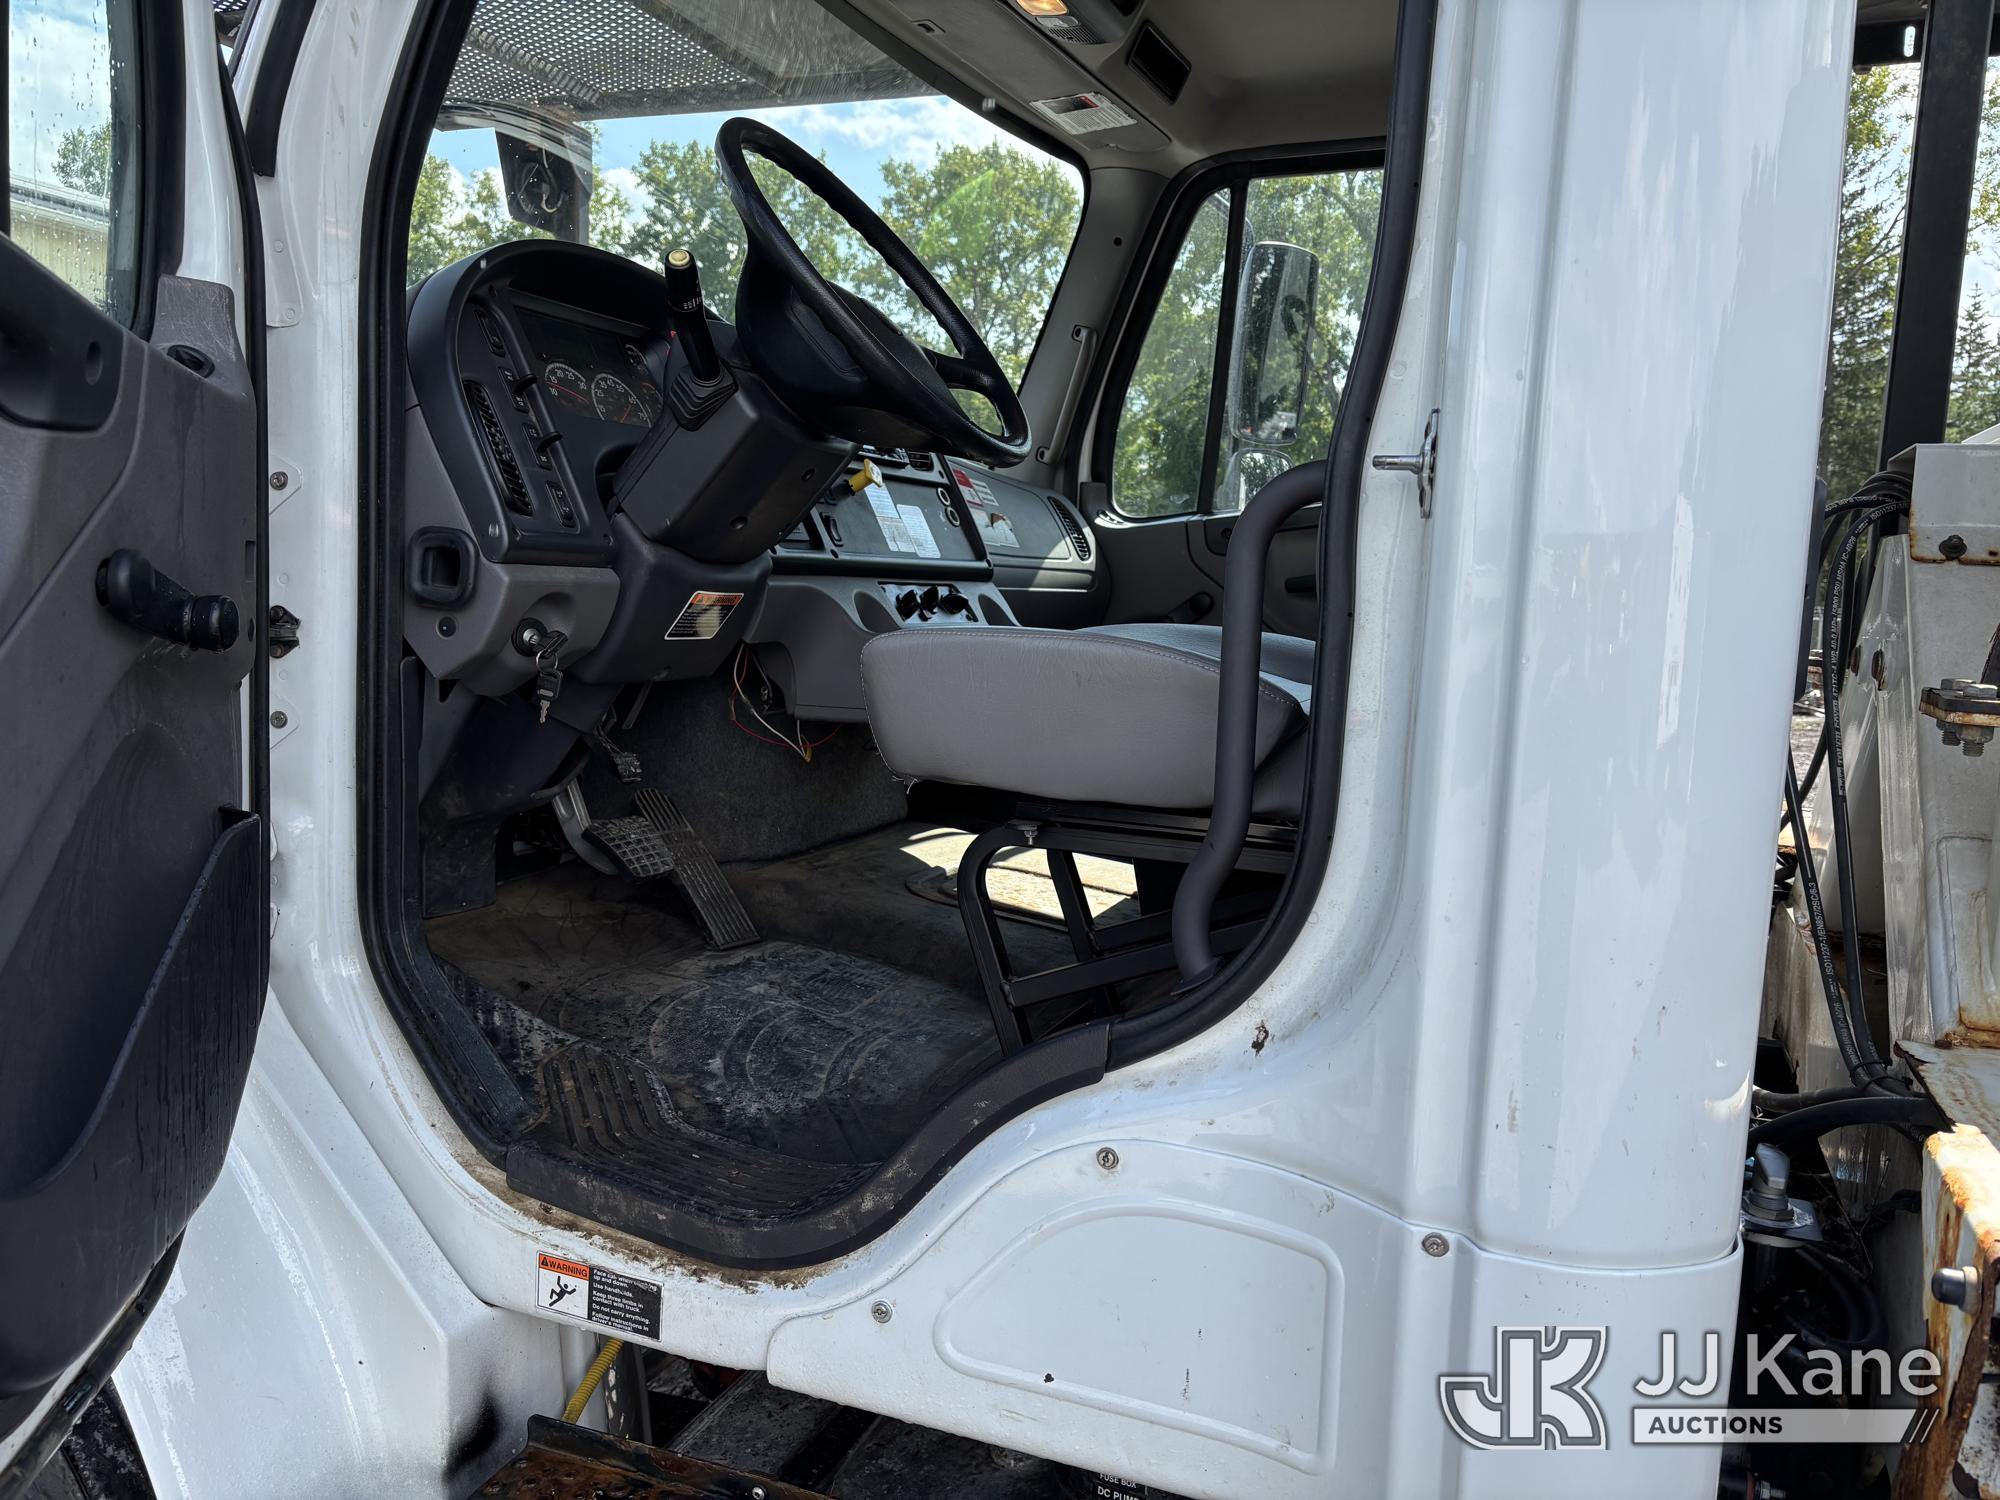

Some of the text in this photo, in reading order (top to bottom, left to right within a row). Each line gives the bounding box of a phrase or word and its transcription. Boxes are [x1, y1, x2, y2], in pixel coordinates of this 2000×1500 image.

[549, 1260, 588, 1277] WARNING
[593, 1269, 606, 1277] Face
[592, 1290, 606, 1299] Keep
[607, 1294, 621, 1302] three
[592, 1296, 612, 1305] contact
[592, 1311, 610, 1320] Follow
[611, 1316, 642, 1330] instructions
[611, 1309, 625, 1317] carry
[625, 1313, 650, 1324] anything.
[1100, 1473, 1137, 1488] FUSE BOX
[1098, 1486, 1111, 1497] DC
